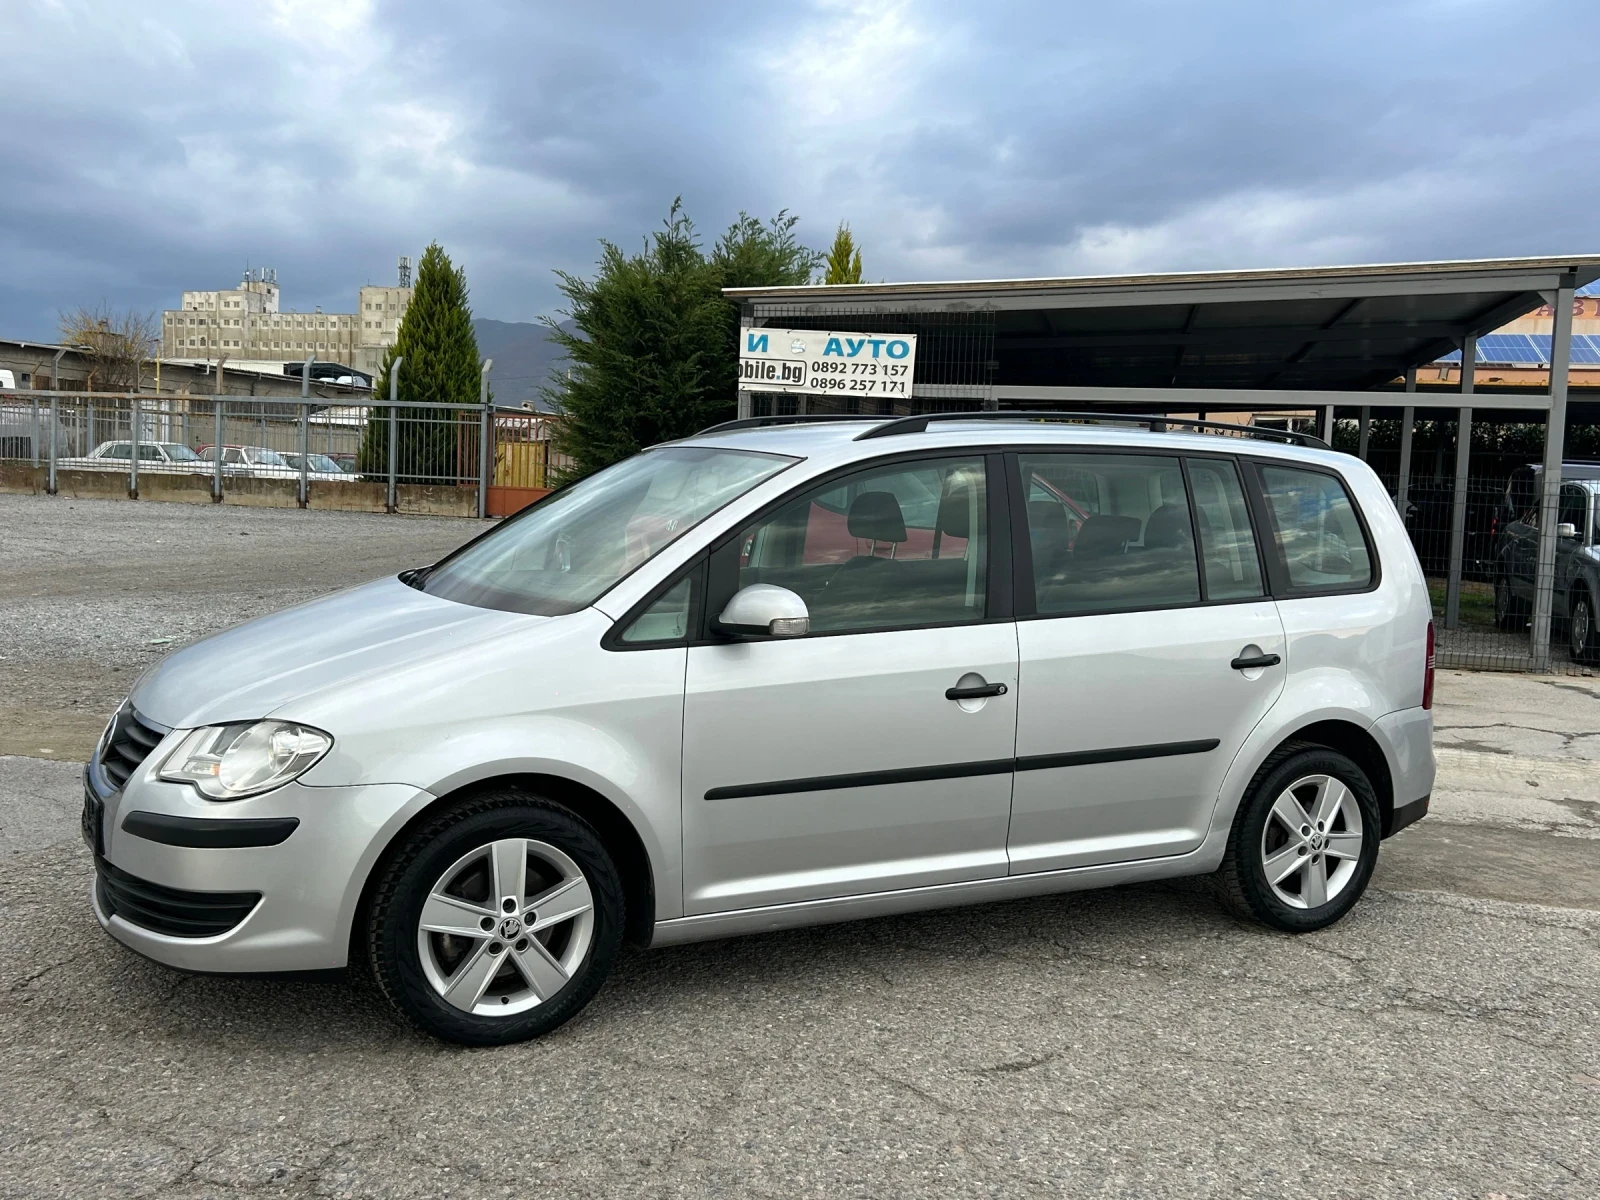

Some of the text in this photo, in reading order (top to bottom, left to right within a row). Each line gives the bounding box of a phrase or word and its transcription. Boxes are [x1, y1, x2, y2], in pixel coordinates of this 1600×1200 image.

[747, 333, 910, 360] И АУТО
[811, 361, 909, 377] 0892 773 157
[810, 377, 906, 393] 0896 257 171
